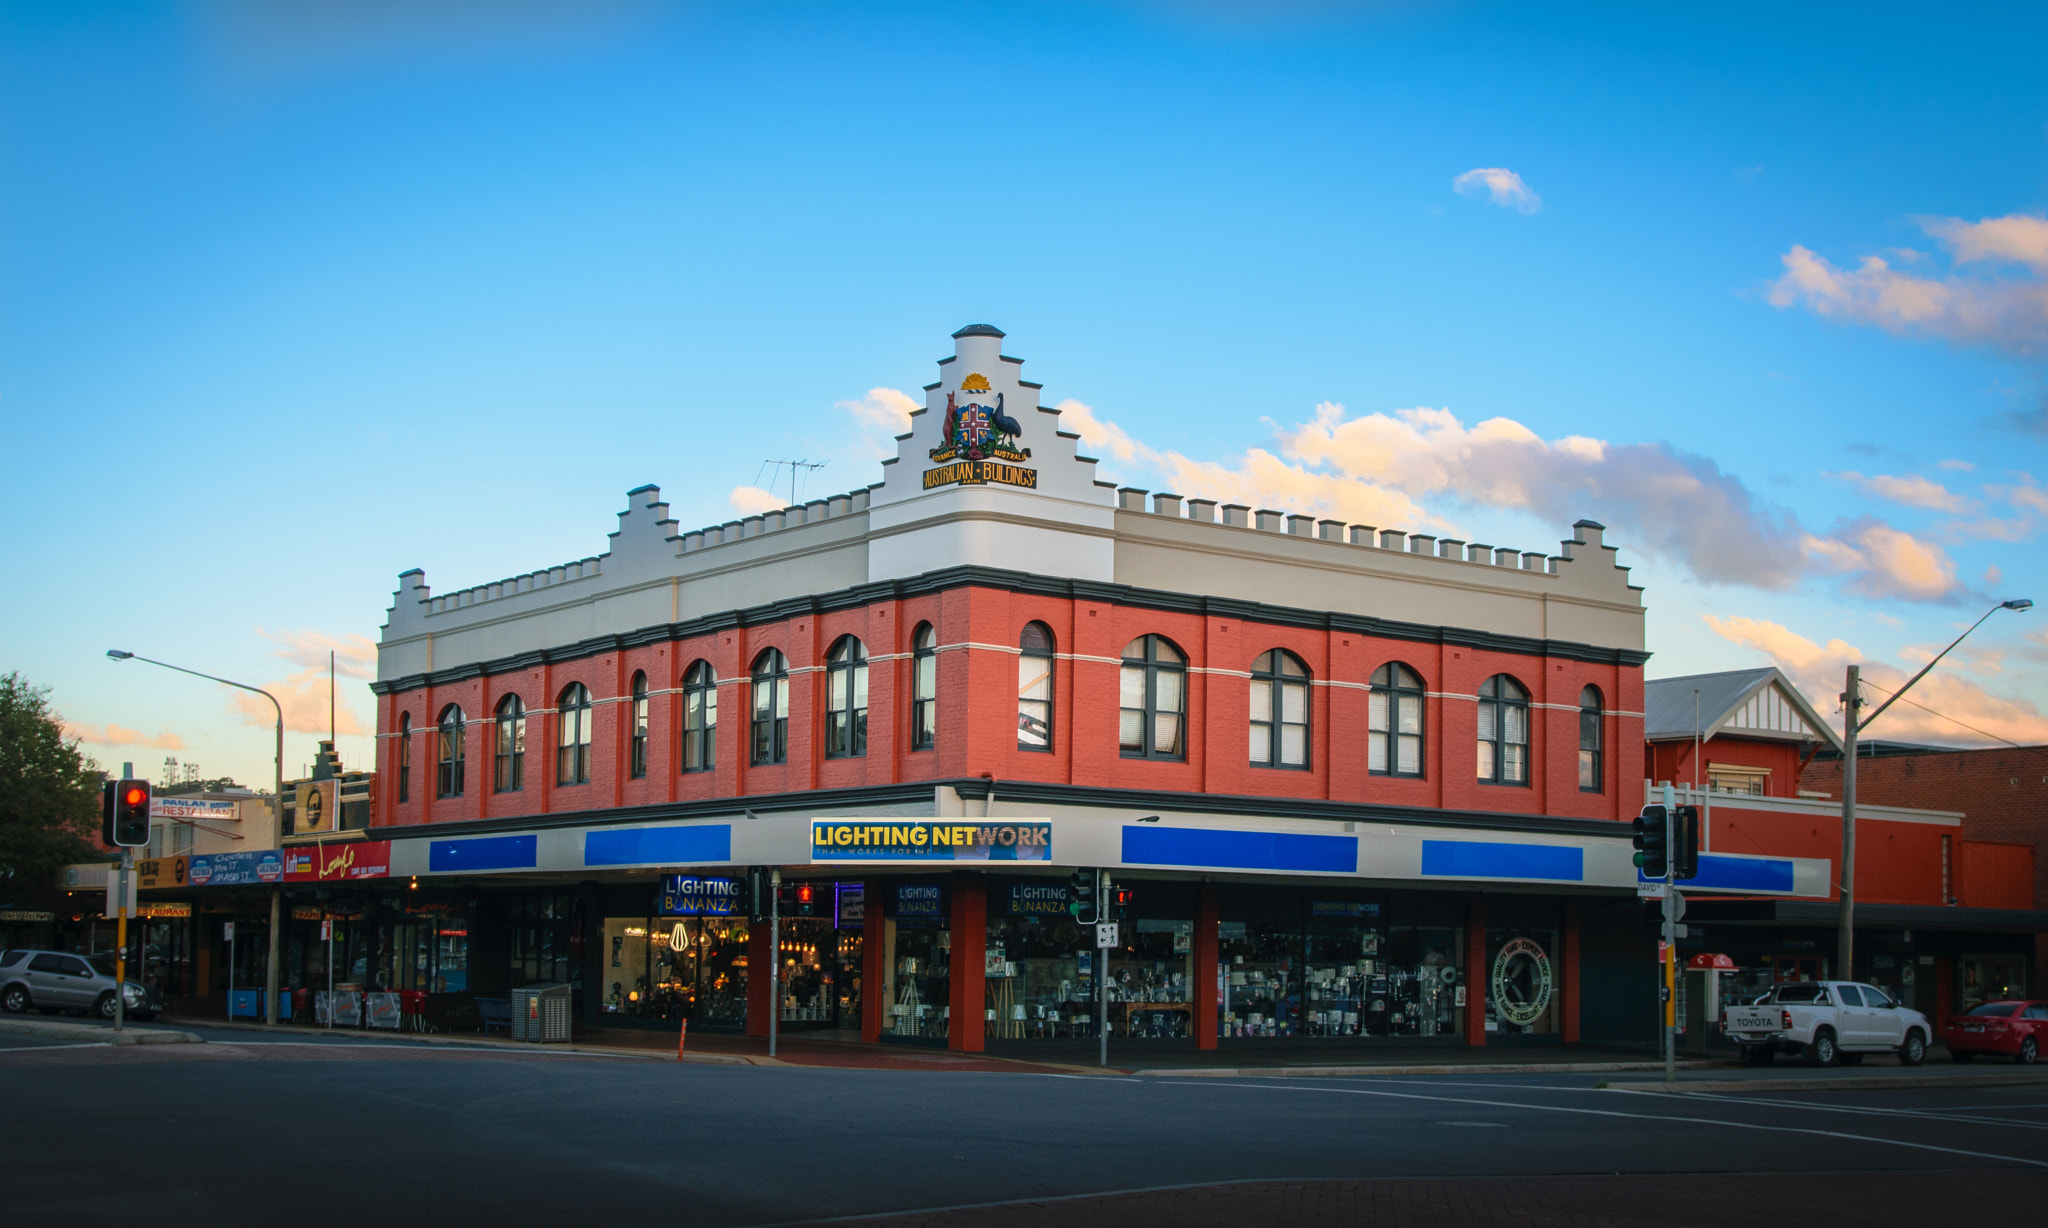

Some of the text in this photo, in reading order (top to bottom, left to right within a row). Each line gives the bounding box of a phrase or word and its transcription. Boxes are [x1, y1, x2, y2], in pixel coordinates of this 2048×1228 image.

[932, 450, 956, 462] ADVANCE
[993, 449, 1028, 462] AUSTRALIA
[925, 462, 1033, 488] AUSTRALIAN BUILDINGS
[162, 799, 206, 807] PANLAN
[162, 806, 236, 818] RESTAURANT
[815, 826, 1048, 846] LIGHTING NETWORK
[286, 854, 298, 873] Loft
[666, 876, 739, 896] LIGHTING
[899, 885, 938, 899] LIGHTING
[1012, 884, 1067, 900] LIGHTING
[665, 896, 738, 912] BONANZA
[898, 901, 936, 912] BONANZA
[1012, 900, 1066, 912] BONANZA
[1313, 902, 1345, 911] LIGHTING
[136, 907, 190, 916] ESTAURANT
[1522, 941, 1540, 957] EXPERT
[1494, 952, 1507, 978] QUALITY
[1736, 1018, 1773, 1026] TOYOTA
